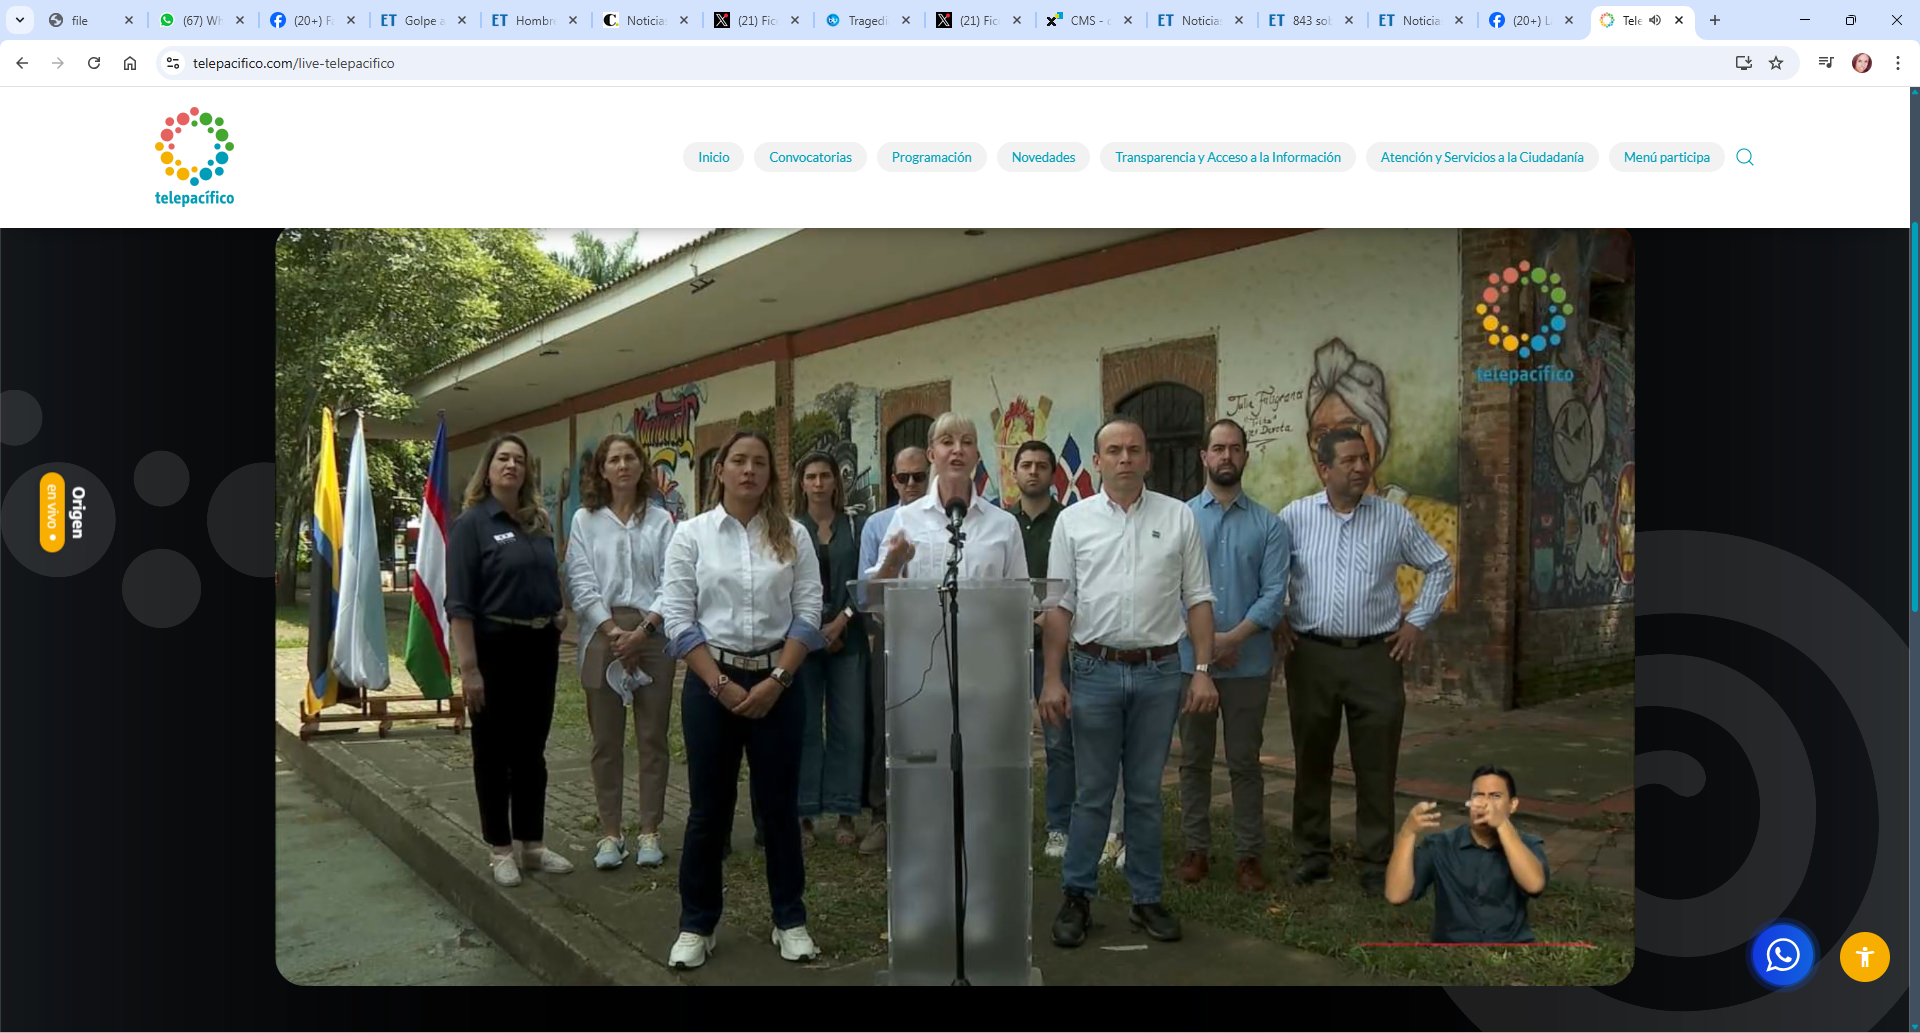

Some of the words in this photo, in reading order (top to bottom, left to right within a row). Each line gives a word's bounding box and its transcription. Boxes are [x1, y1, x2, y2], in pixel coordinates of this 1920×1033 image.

[72, 16, 88, 25] file
[184, 16, 203, 28] (67)
[295, 16, 322, 28] (20+)
[381, 14, 397, 27] ET
[405, 16, 437, 28] Golpe
[492, 14, 508, 27] ET
[628, 16, 668, 25] Noticias
[739, 16, 758, 28] (21)
[961, 16, 980, 28] (21)
[1071, 16, 1095, 25] CMS
[1158, 14, 1174, 27] ET
[1183, 16, 1223, 25] Noticias
[1269, 14, 1285, 27] ET
[1293, 16, 1312, 25] 843
[1379, 14, 1395, 27] ET
[1514, 16, 1541, 28] (20+)
[1623, 16, 1643, 25] Tele
[193, 57, 395, 72] telepacifico.com/live-telepacifico
[699, 152, 730, 163] Inicio
[769, 152, 852, 163] Convocatorias
[893, 152, 972, 165] Programación
[1012, 152, 1076, 163] Novedades
[1115, 152, 1195, 165] Transparencia
[1198, 154, 1205, 165] y
[1207, 152, 1248, 163] Acceso
[1250, 154, 1257, 163] a
[1260, 152, 1269, 163] la
[1273, 152, 1341, 163] Información
[1380, 152, 1433, 163] Atención
[1435, 154, 1442, 165] y
[1444, 152, 1496, 163] Servicios
[1497, 155, 1504, 163] a
[1508, 152, 1517, 163] la
[1520, 152, 1584, 163] Ciudadanía
[1625, 152, 1657, 163] Menú
[1660, 152, 1710, 165] participa
[155, 190, 234, 207] telepacífico
[47, 484, 56, 500] en
[47, 502, 59, 529] vivo
[68, 486, 86, 539] Origen
